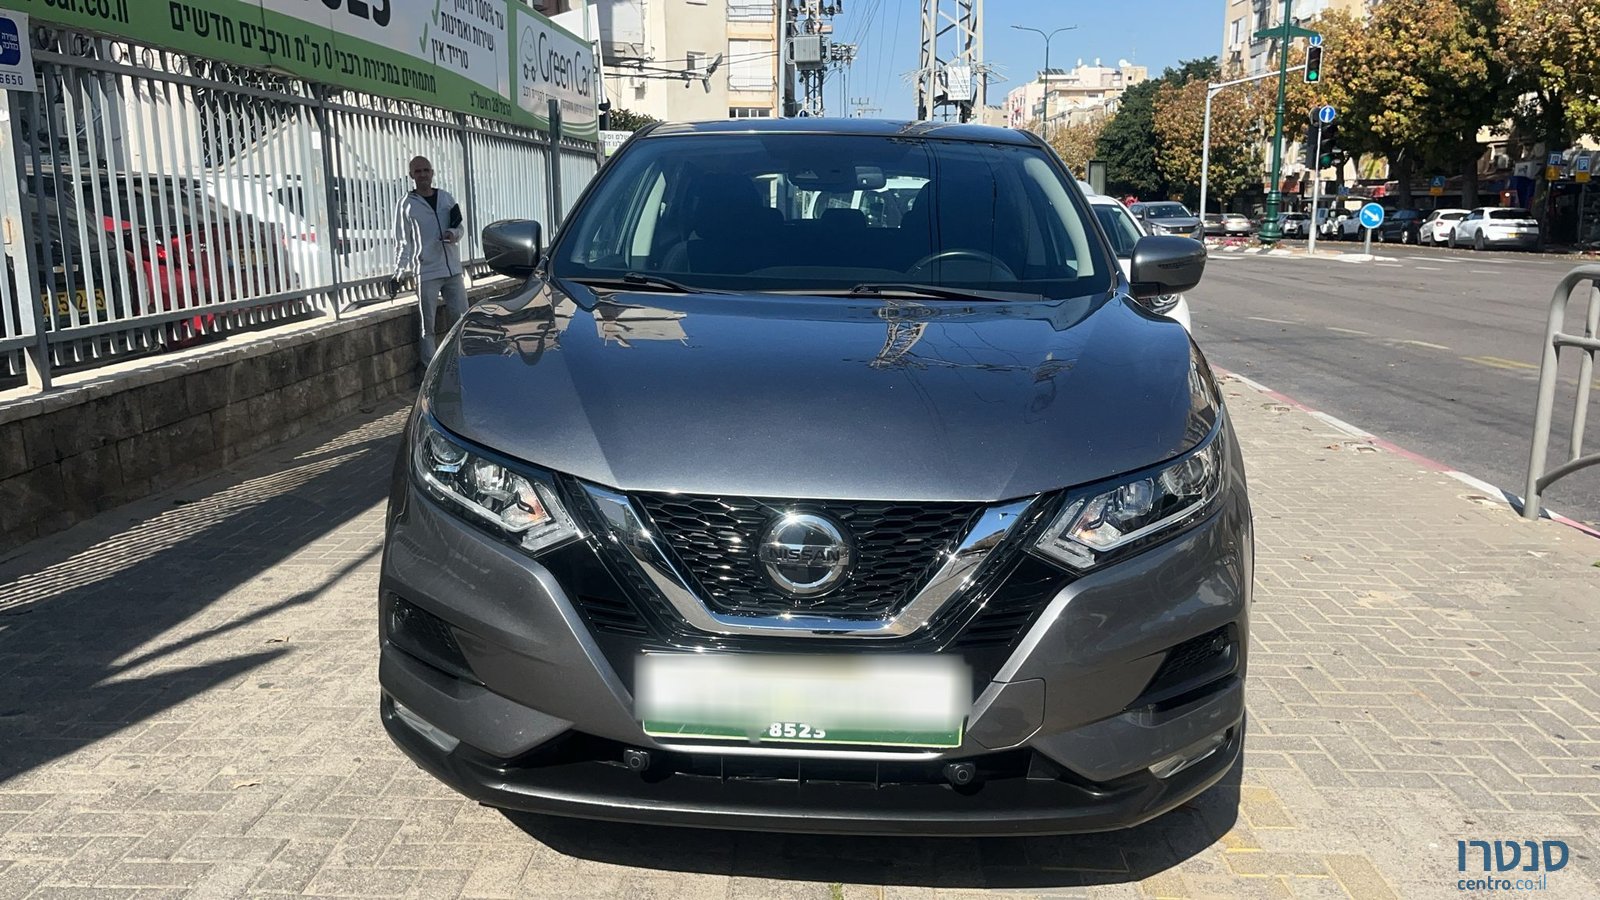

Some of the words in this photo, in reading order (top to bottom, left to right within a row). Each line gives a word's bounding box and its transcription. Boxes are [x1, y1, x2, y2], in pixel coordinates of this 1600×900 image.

[169, 1, 236, 45] חדשים
[440, 11, 472, 42] ואמינות
[494, 10, 504, 31] עד
[239, 21, 291, 59] ורכבים
[294, 33, 321, 68] ק"מ
[431, 38, 446, 65] אין
[472, 26, 494, 52] שירות
[335, 49, 362, 77] רכבי
[446, 44, 469, 69] טרייד
[538, 31, 574, 93] Green
[574, 50, 592, 98] Car
[363, 57, 401, 86] במכירת
[401, 67, 437, 94] מתמחים
[768, 548, 841, 563] NISSAN
